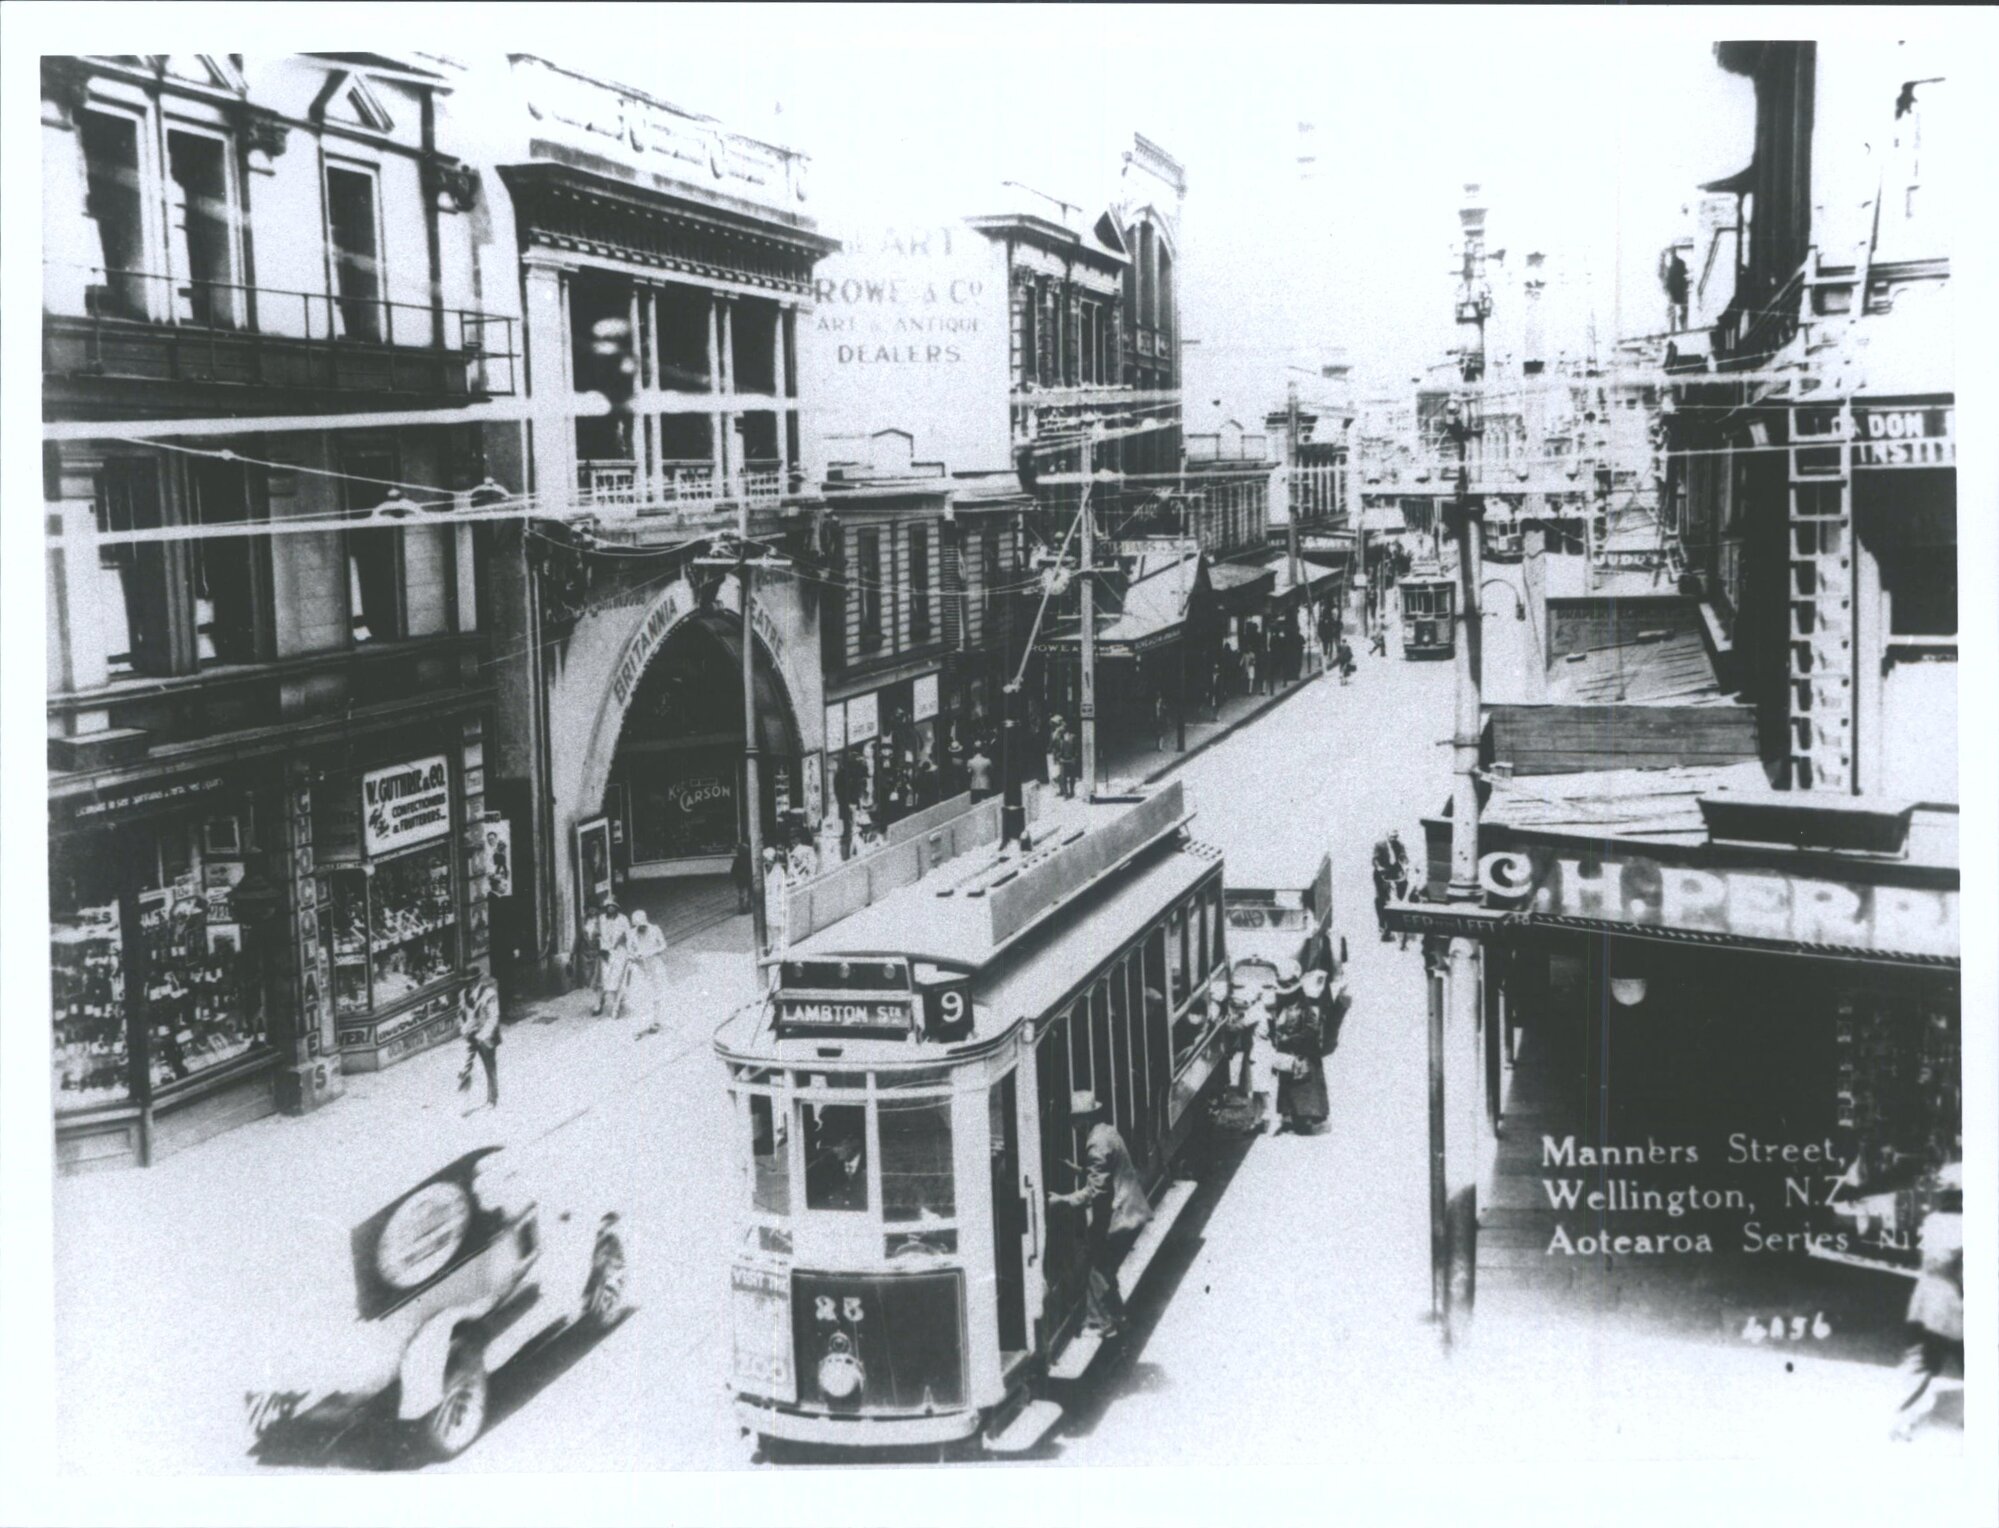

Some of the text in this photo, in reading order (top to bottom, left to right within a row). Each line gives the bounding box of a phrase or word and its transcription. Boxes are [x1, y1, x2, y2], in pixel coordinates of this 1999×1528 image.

[814, 278, 905, 304] ROWE
[816, 316, 855, 332] ART
[837, 344, 962, 364] DEALERS
[614, 594, 679, 706] BRITANNIA
[365, 780, 379, 807] W.
[679, 784, 731, 813] CARSON
[297, 785, 328, 1091] CHOCOLATES
[782, 1003, 868, 1024] LAMBTON
[940, 991, 964, 1023] 9
[815, 1296, 865, 1322] 25
